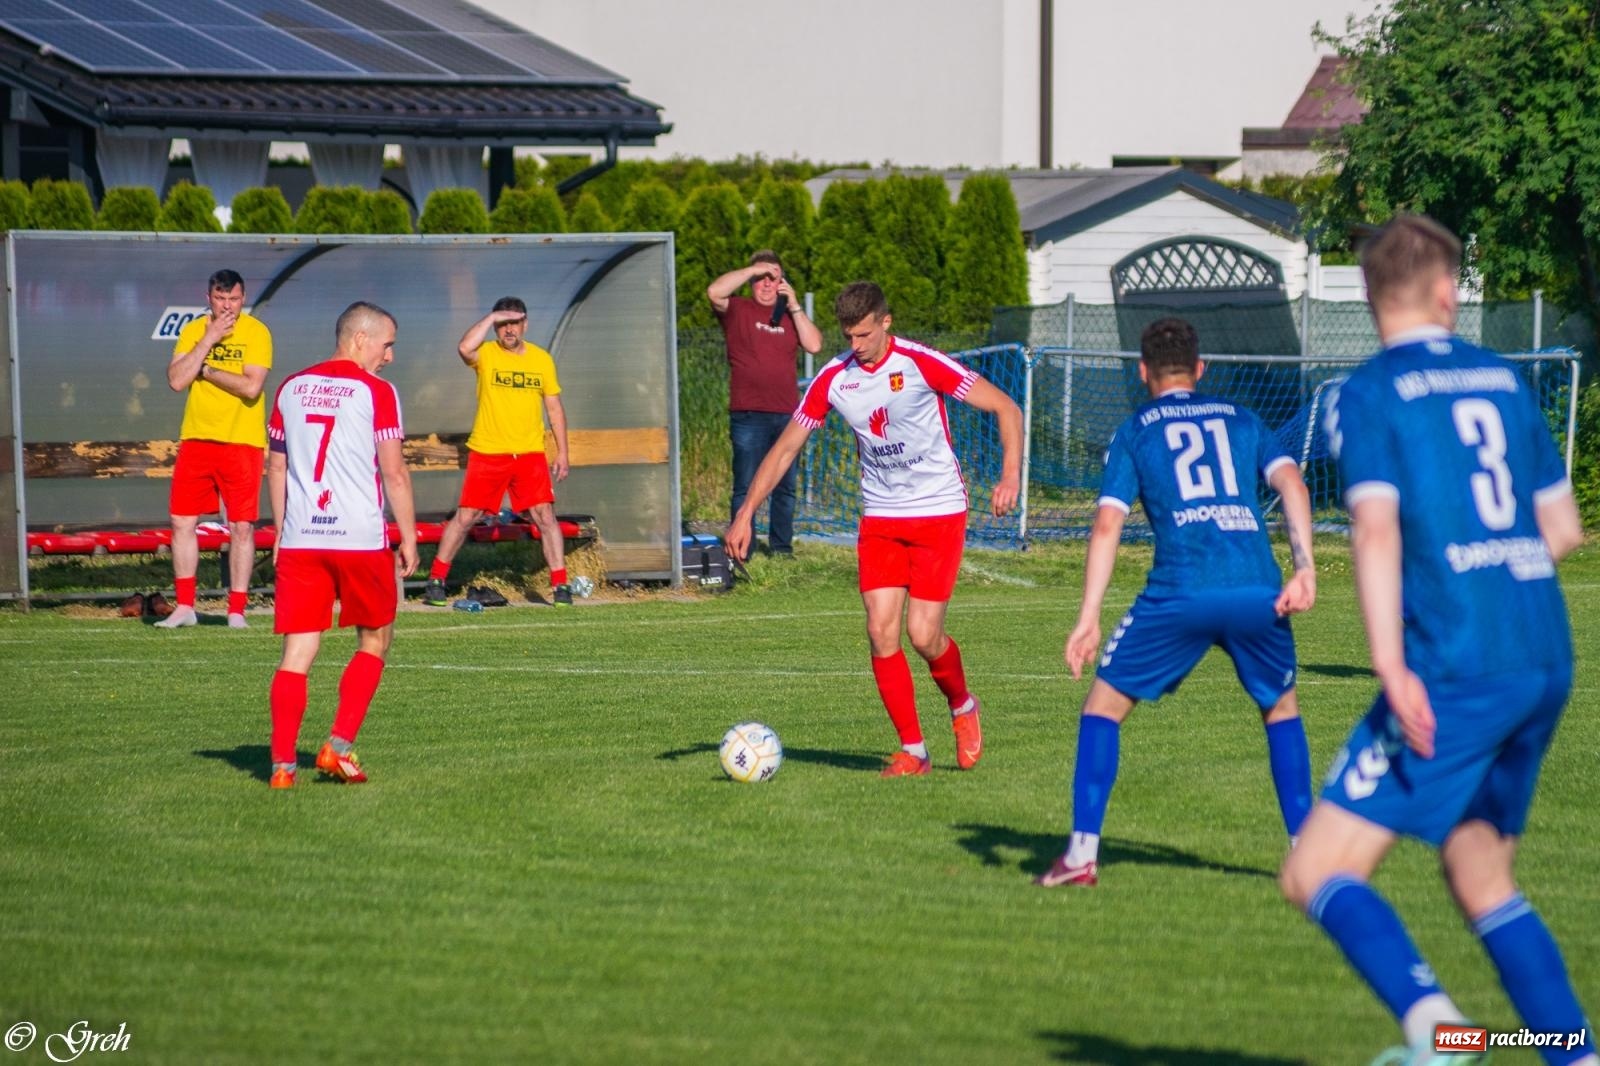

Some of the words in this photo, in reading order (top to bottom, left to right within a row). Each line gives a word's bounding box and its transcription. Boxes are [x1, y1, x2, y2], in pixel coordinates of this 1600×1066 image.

[293, 384, 308, 395] LKS
[311, 384, 355, 398] ZAMECZEK
[301, 396, 340, 409] CZERNICA
[305, 413, 336, 483] 7
[1164, 418, 1239, 502] 21
[1452, 397, 1517, 531] 3
